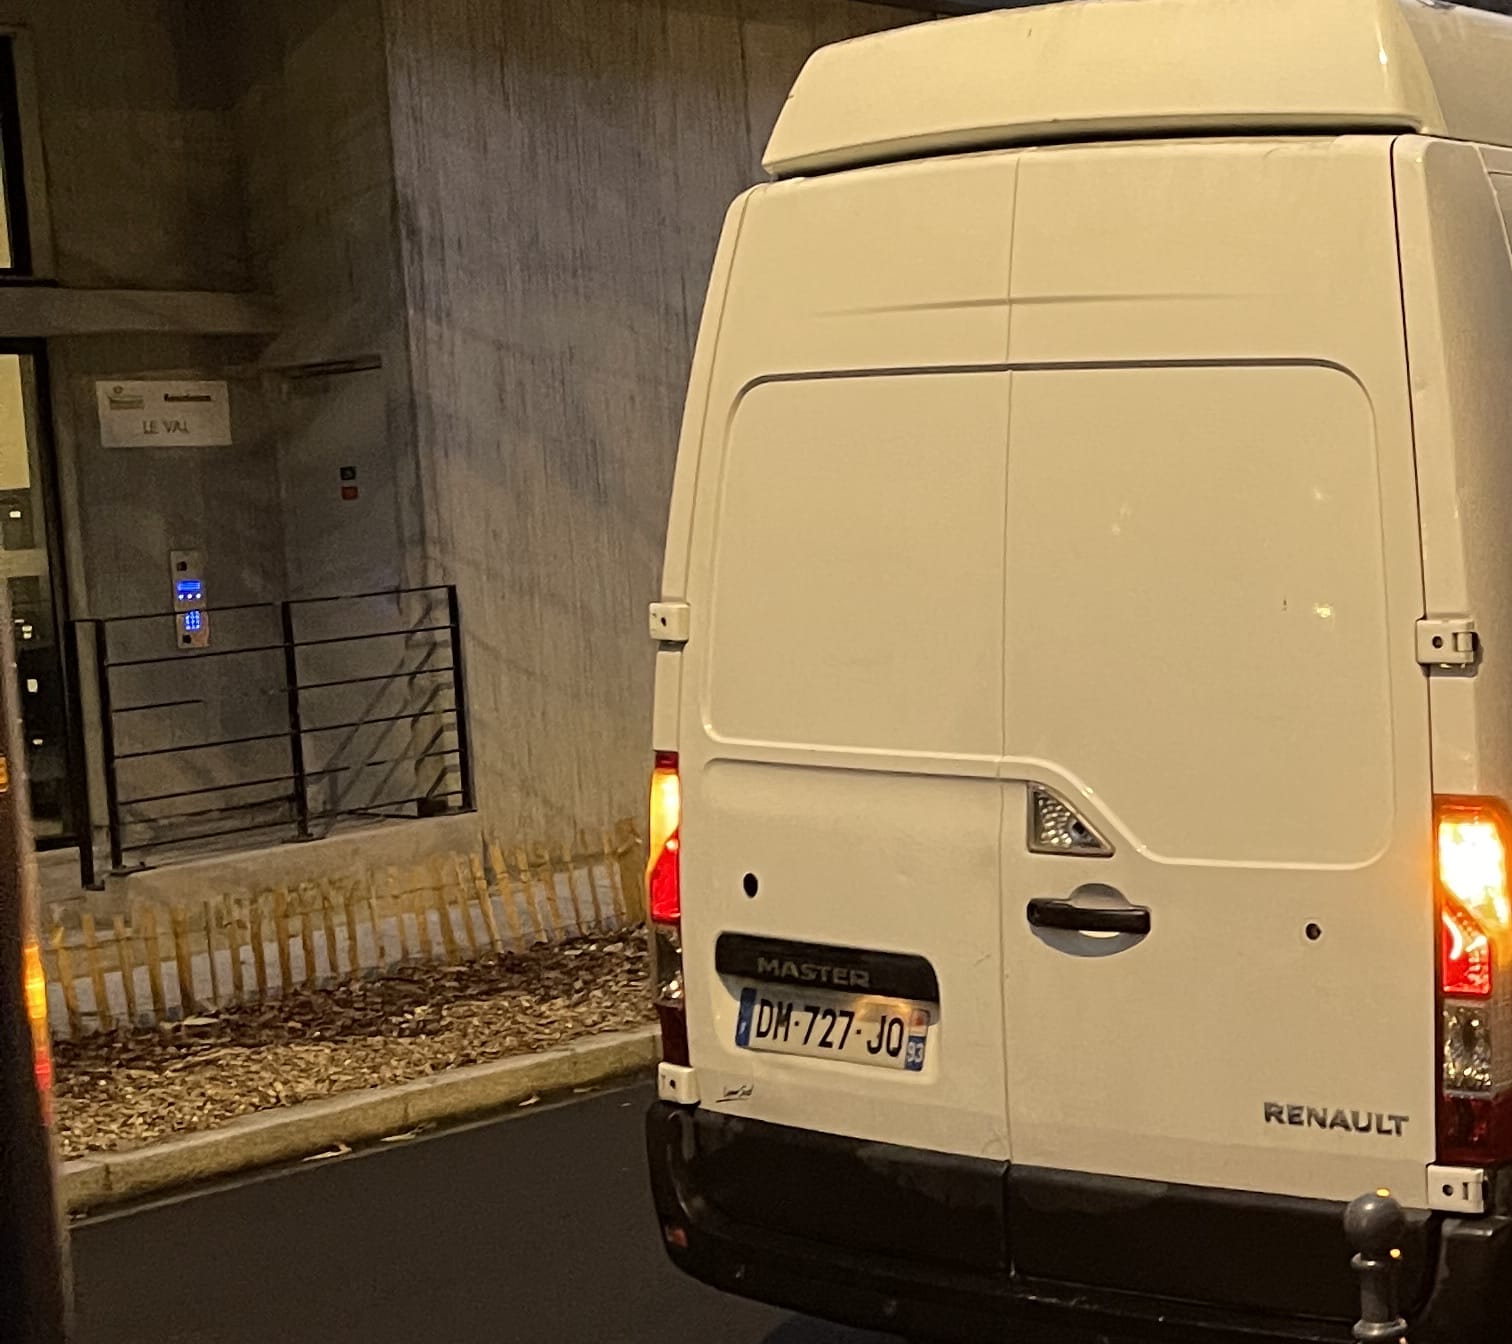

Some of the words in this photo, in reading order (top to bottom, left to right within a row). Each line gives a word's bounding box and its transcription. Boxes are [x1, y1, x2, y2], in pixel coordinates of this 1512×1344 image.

[756, 956, 871, 989] MASTER
[906, 1041, 925, 1064] 93
[1263, 1101, 1410, 1138] RENAULT
